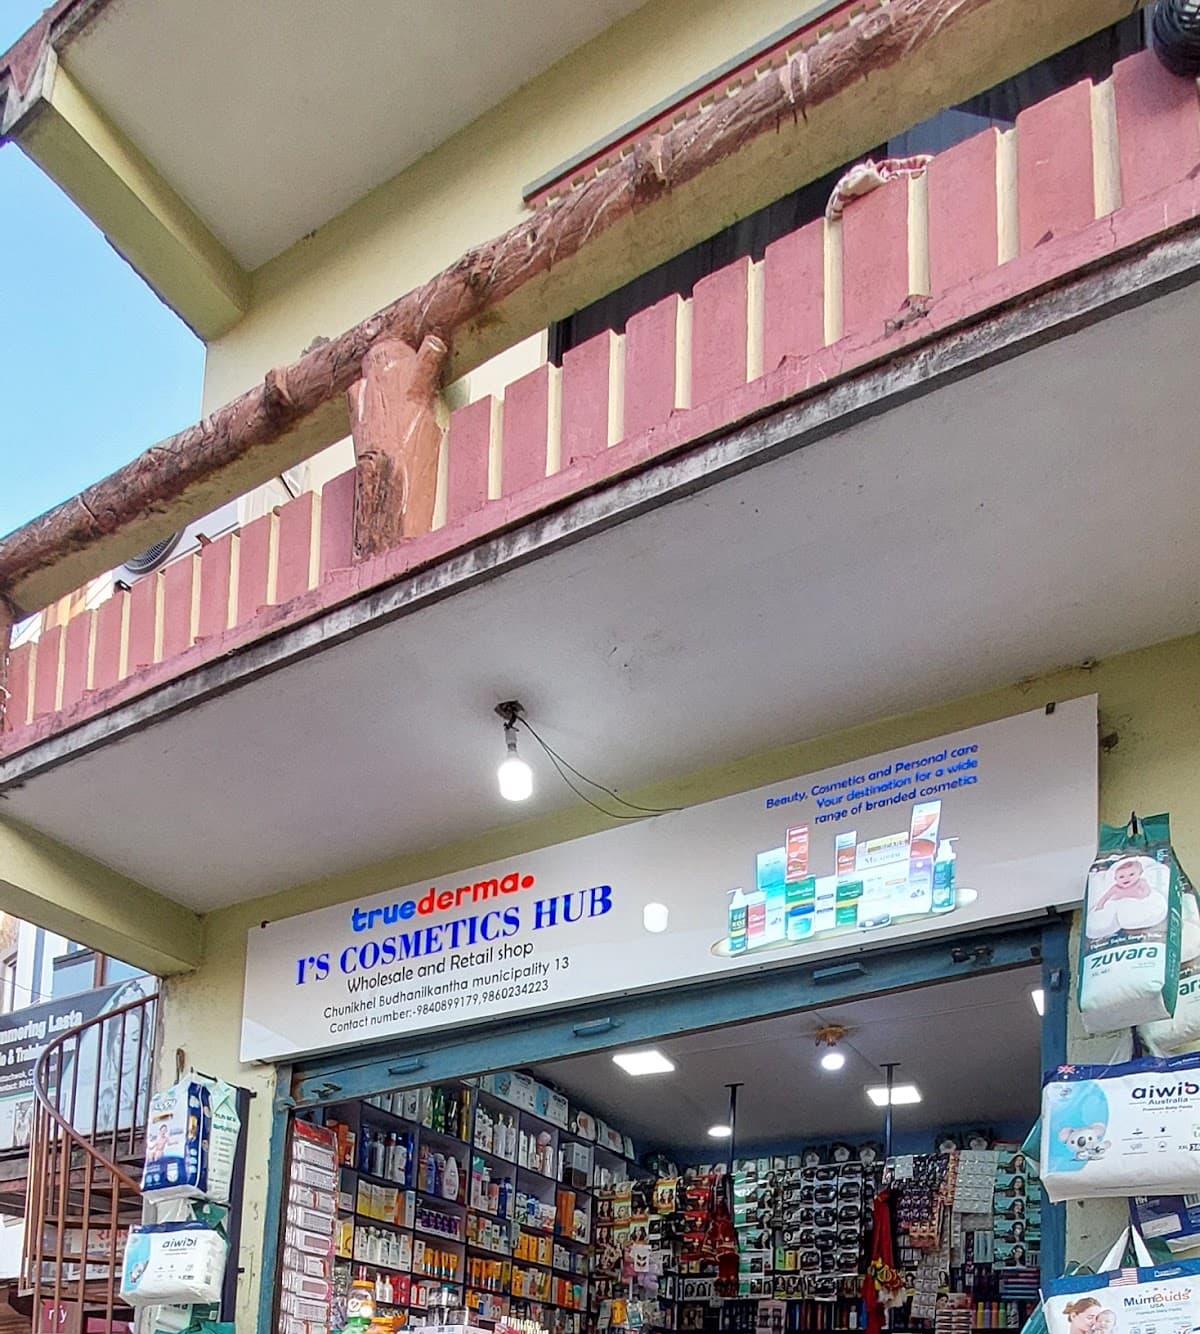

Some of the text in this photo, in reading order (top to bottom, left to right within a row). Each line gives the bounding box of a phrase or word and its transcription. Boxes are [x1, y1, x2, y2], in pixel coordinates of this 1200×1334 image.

[766, 744, 978, 808] Beauty, Cosmetics and Personal care
[815, 775, 977, 824] range of branded cosmetics
[816, 759, 978, 808] Your destination for a wide
[340, 906, 520, 975] COSMETICS
[532, 885, 613, 930] HUB
[347, 942, 534, 993] Wholesale and Retail shop
[1090, 946, 1158, 969] zuvara
[323, 956, 570, 1018] Chunikhel Budhanilkantha municipality 13
[329, 1017, 368, 1034] Contact
